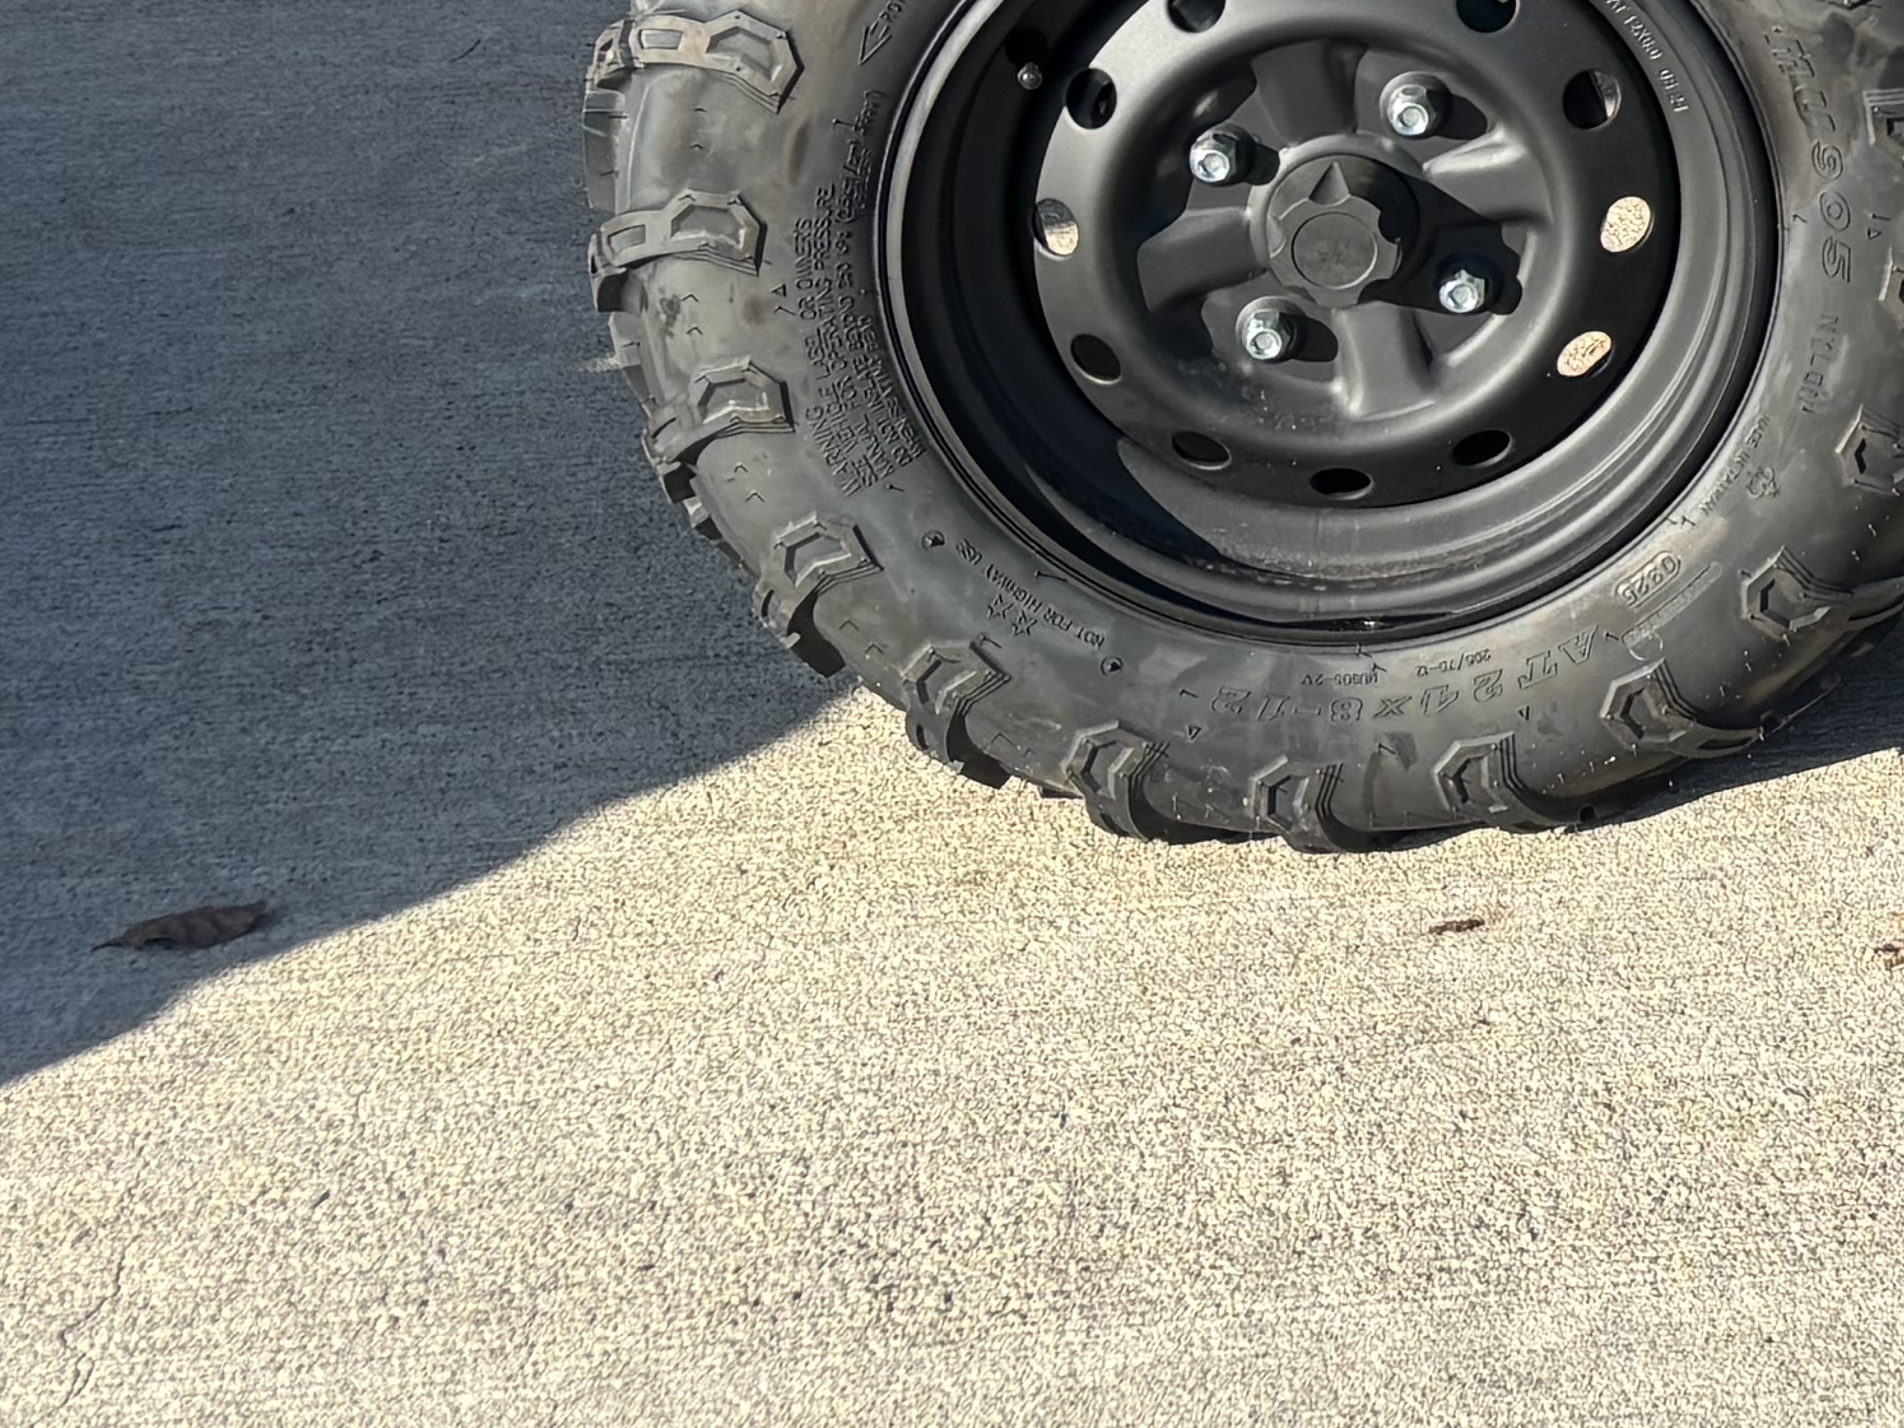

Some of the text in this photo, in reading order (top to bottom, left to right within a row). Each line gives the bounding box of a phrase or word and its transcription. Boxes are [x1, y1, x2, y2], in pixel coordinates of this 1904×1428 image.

[796, 295, 817, 321] OR
[803, 404, 861, 496] WARNING
[980, 562, 1043, 614] HIGHWAY
[1042, 607, 1073, 632] FOR
[1074, 624, 1105, 650] NOT
